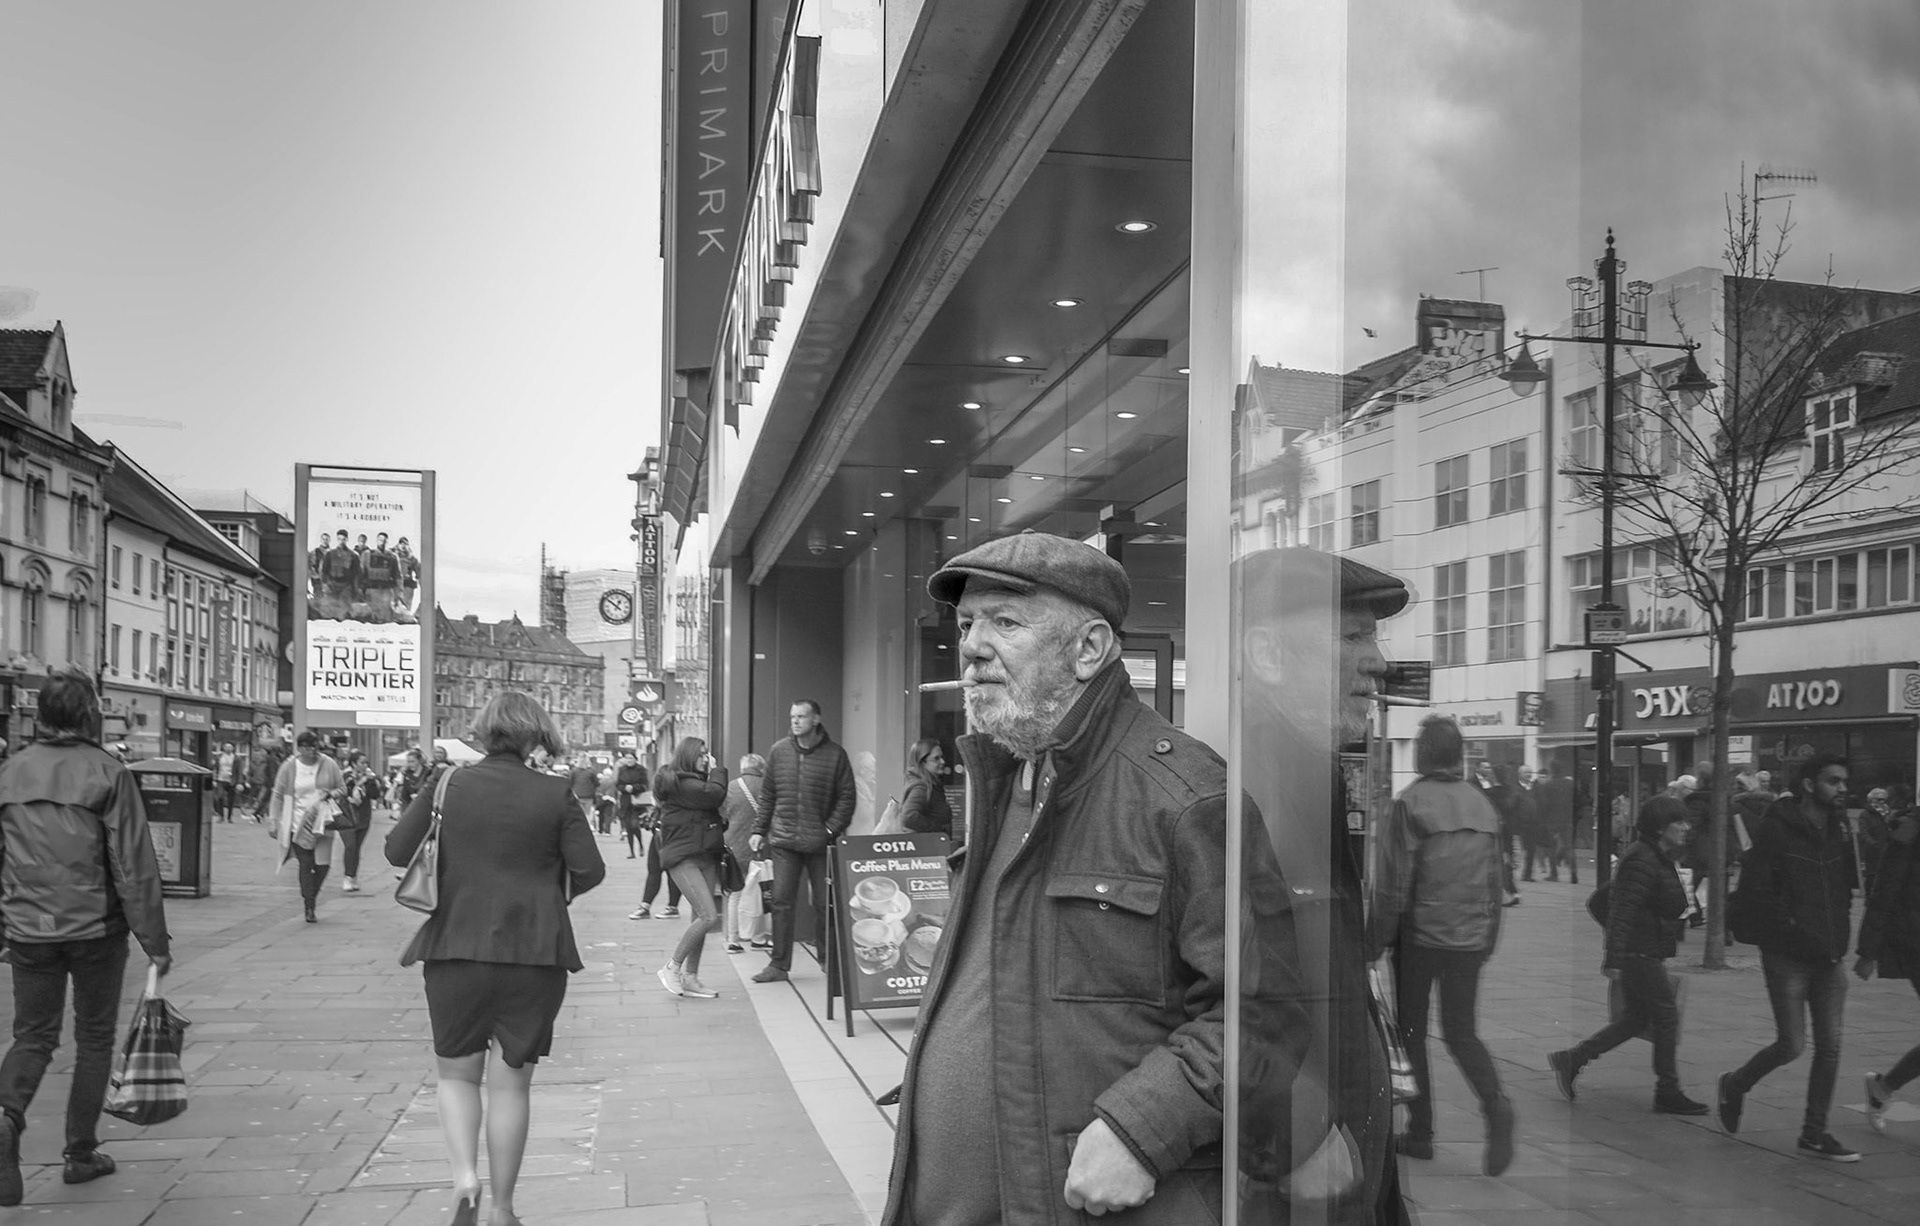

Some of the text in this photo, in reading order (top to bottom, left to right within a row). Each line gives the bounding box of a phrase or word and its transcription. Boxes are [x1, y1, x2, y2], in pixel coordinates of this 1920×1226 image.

[697, 10, 729, 257] PRIMARK
[644, 516, 656, 565] TATTOO
[312, 645, 414, 671] TRIPLE
[312, 671, 414, 689] FRONTIER
[872, 841, 916, 853] COSTA
[850, 859, 941, 873] Coffee Plus Menu
[886, 975, 928, 988] COSTA
